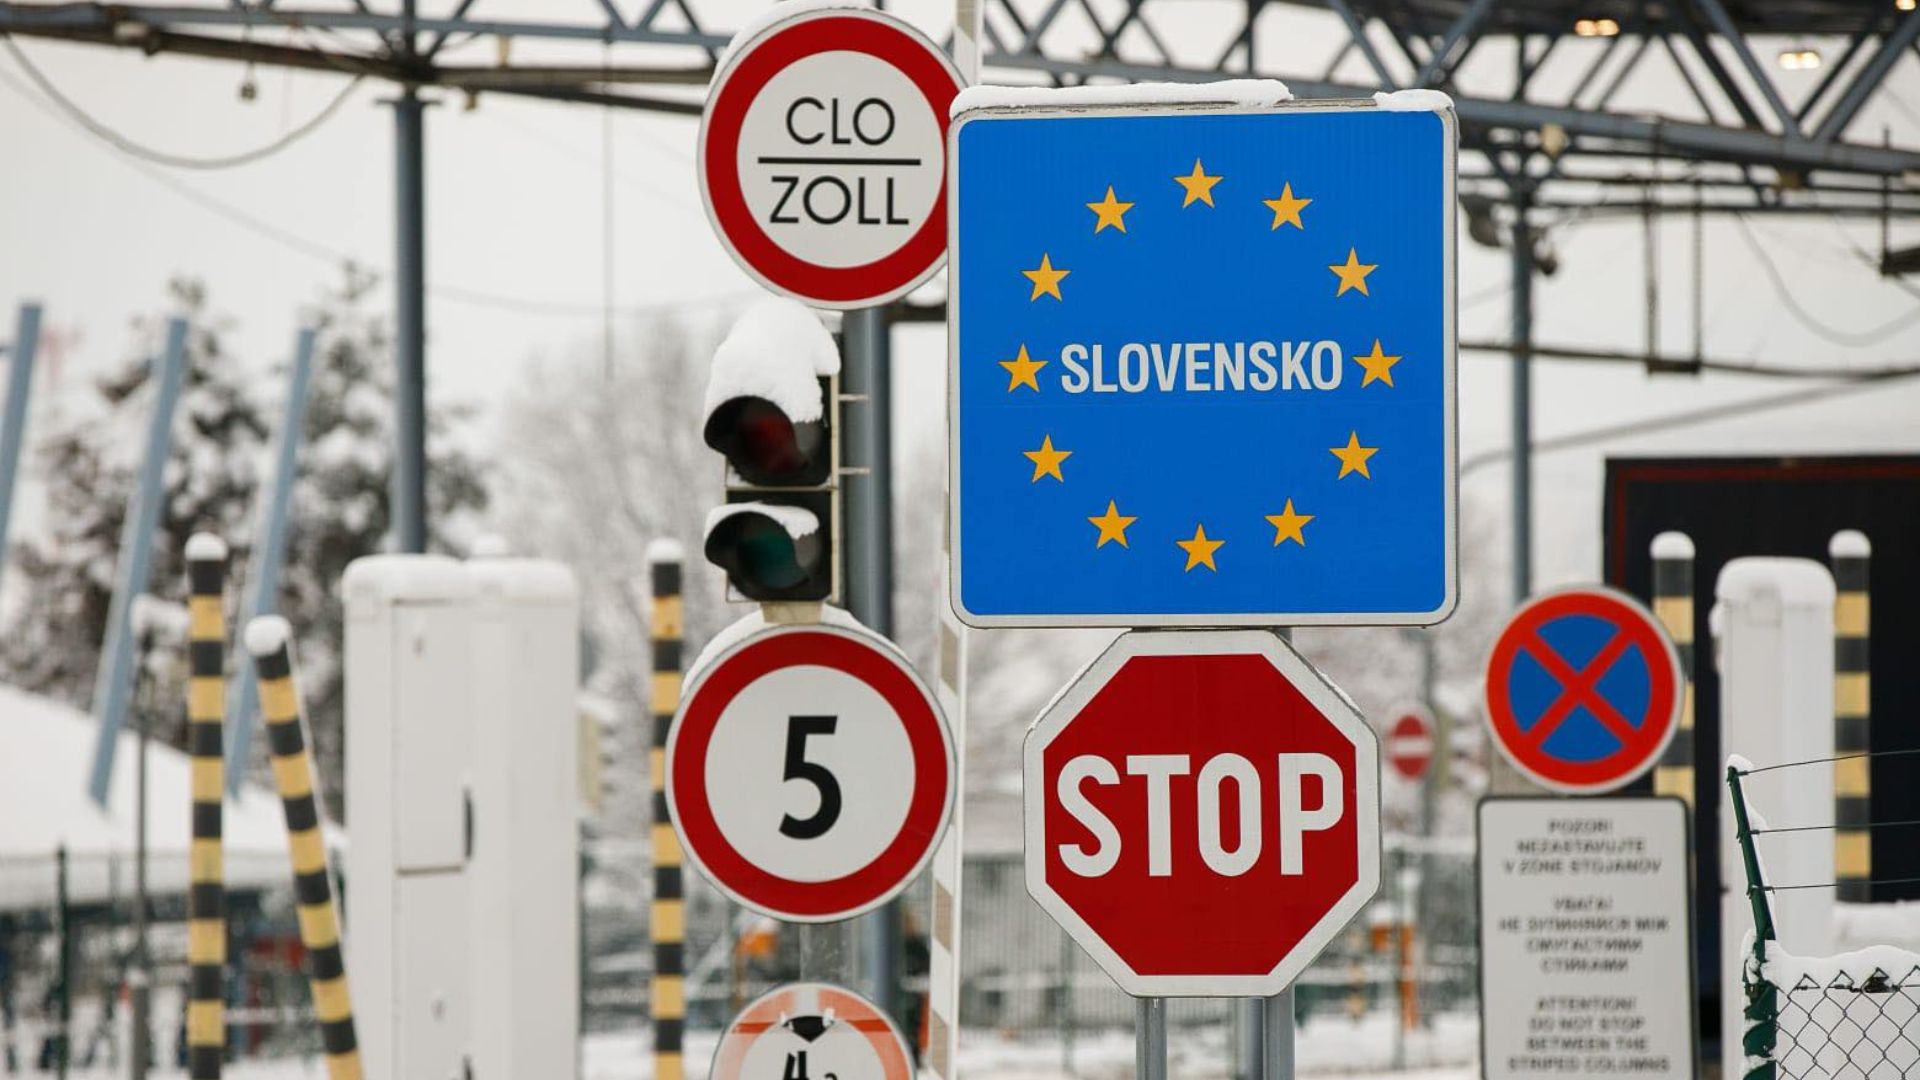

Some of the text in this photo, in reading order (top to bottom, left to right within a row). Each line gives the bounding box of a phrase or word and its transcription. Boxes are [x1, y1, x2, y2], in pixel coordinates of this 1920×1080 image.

[786, 97, 895, 145] CLO
[769, 176, 909, 225] ZOLL
[1060, 339, 1343, 394] SLOVENSKO
[778, 715, 842, 840] 5
[1057, 752, 1344, 878] STOP
[1526, 1037, 1649, 1053] BETWEEN THE
[1530, 1017, 1645, 1032] DO NOT STOP
